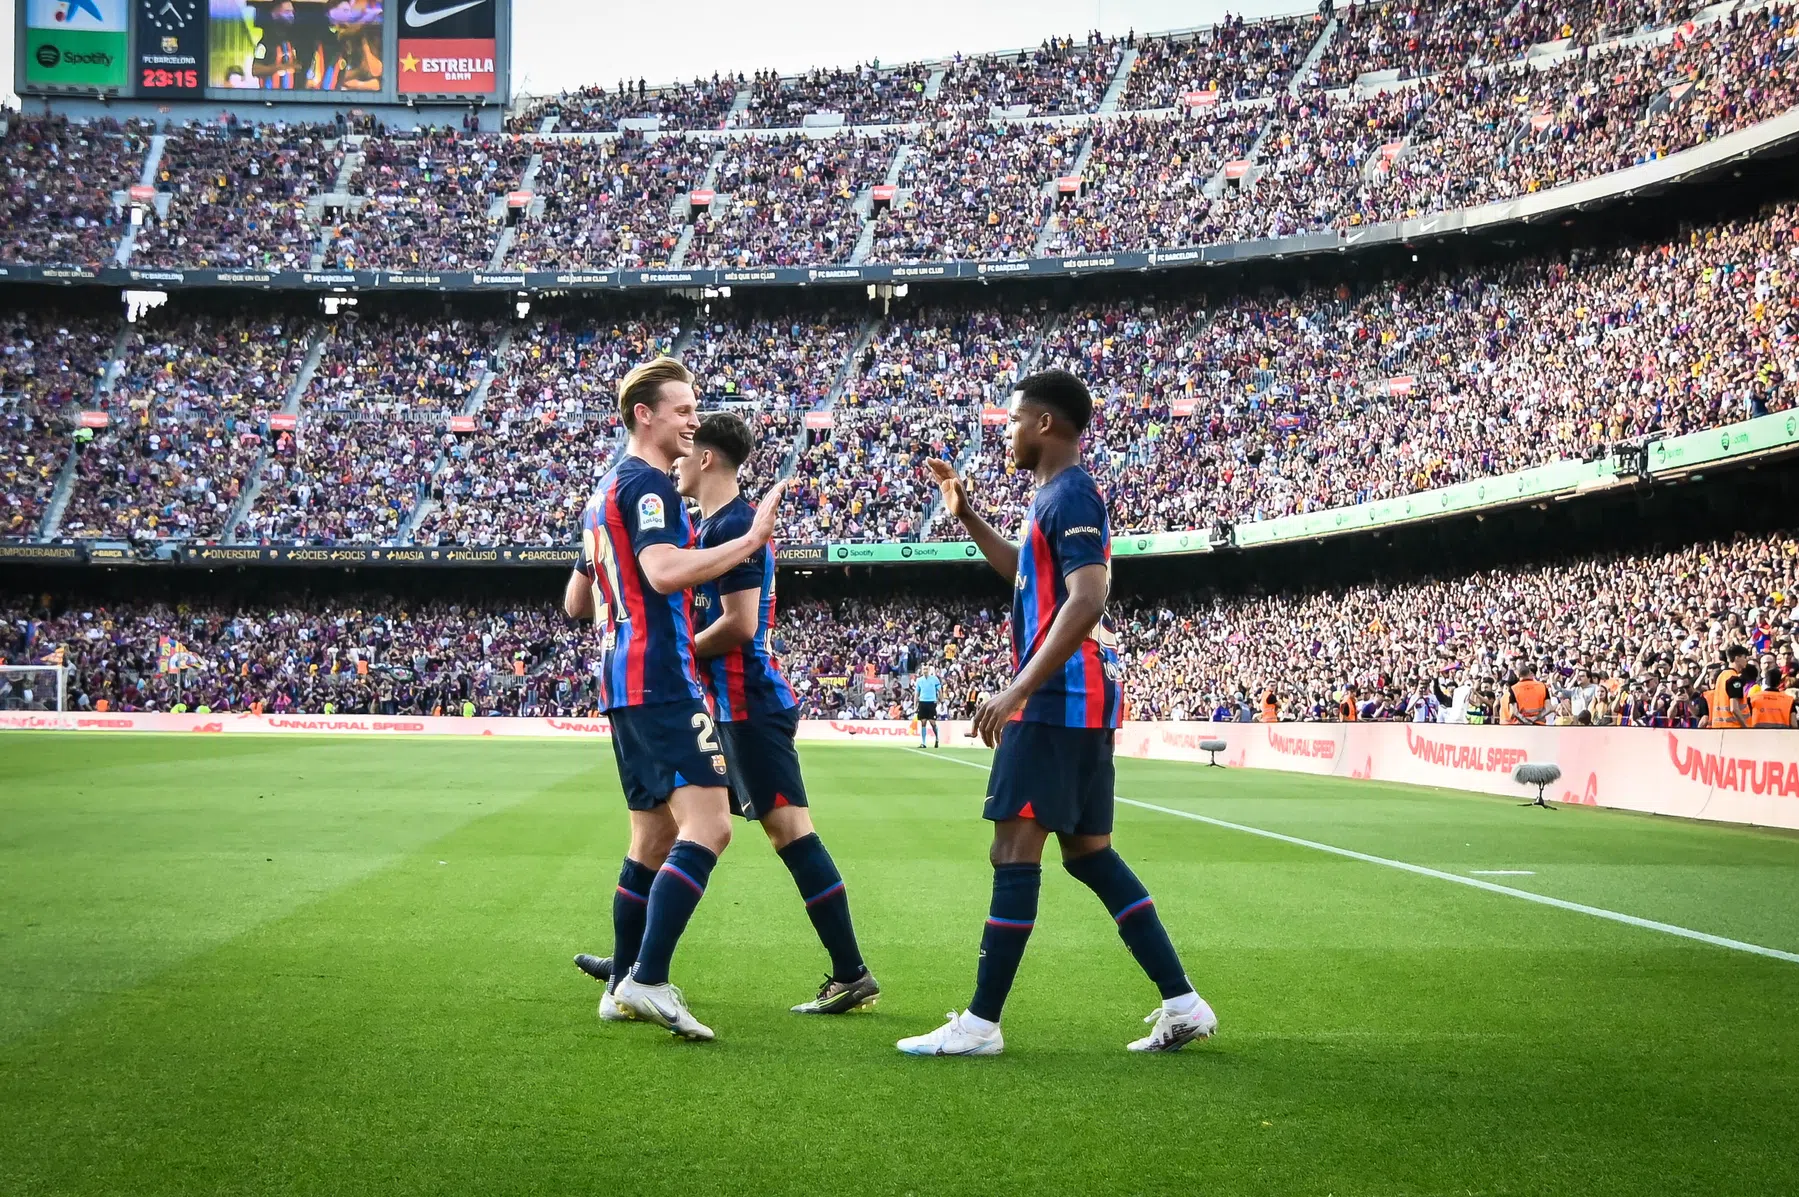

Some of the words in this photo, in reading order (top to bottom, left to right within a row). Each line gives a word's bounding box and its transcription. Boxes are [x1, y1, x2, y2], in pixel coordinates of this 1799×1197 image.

[64, 51, 114, 68] Spotify
[153, 56, 196, 64] BARCELONA
[422, 58, 494, 73] ESTRELLA
[143, 69, 198, 88] 23:15
[444, 72, 472, 81] DAMM
[1157, 254, 1164, 262] FC
[1165, 251, 1199, 261] BARCELONA
[987, 264, 995, 272] FC
[995, 263, 1029, 272] BARCELONA
[818, 270, 826, 278] FC
[826, 269, 859, 278] BARCELONA
[1064, 526, 1099, 537] AMBILIGHT
[0, 548, 76, 558] EMPODERAMENT
[211, 550, 260, 559] DIVERSITAT
[339, 550, 366, 560] SOCIS
[455, 549, 497, 560] INCLUSIÓ
[527, 551, 580, 560] BARCELONA
[914, 548, 938, 556] Spotify
[694, 592, 712, 609] tify
[269, 718, 369, 730] UNNATURAL
[372, 722, 424, 731] SPEED
[546, 718, 614, 733] UNNAT
[830, 721, 921, 737] UNNATURL
[691, 713, 719, 752] 2
[1268, 725, 1311, 757] UNNATURAL
[1311, 739, 1335, 759] SPEED
[1405, 724, 1484, 771] UNNATURAL
[1667, 731, 1799, 798] UNNATURA
